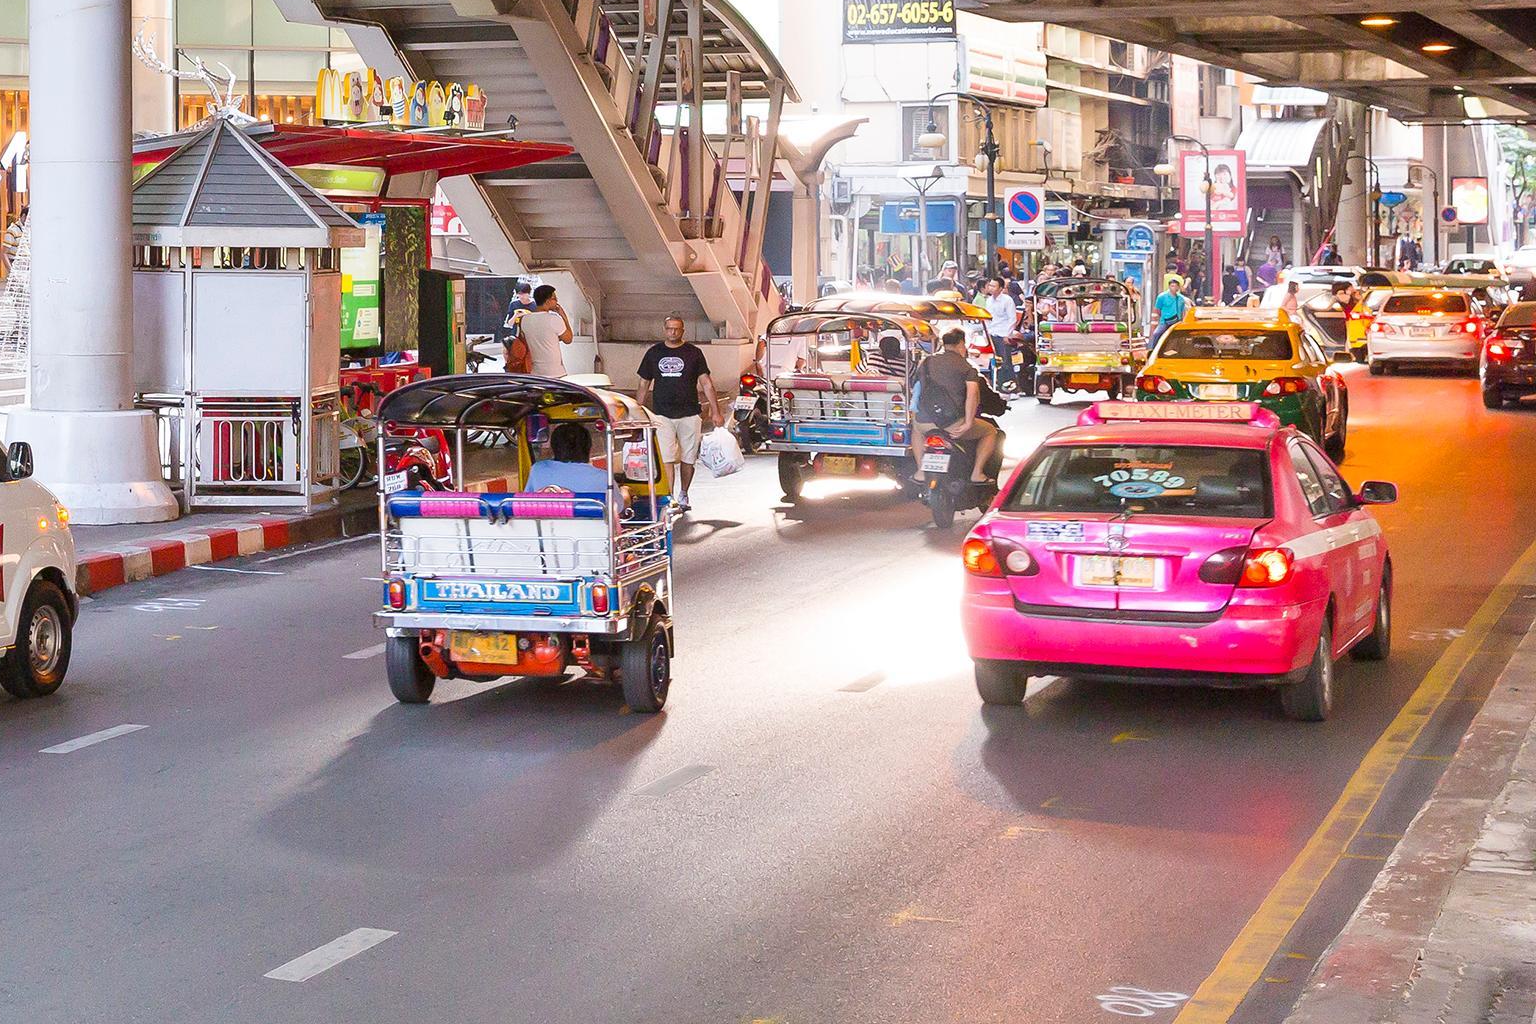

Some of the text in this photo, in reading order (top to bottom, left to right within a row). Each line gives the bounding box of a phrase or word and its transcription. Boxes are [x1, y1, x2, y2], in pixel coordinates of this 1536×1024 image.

[846, 0, 954, 26] 02-657-6055-6
[1127, 404, 1242, 419] TAXI-METER
[1092, 468, 1186, 488] 70589
[435, 583, 560, 601] THAILAND
